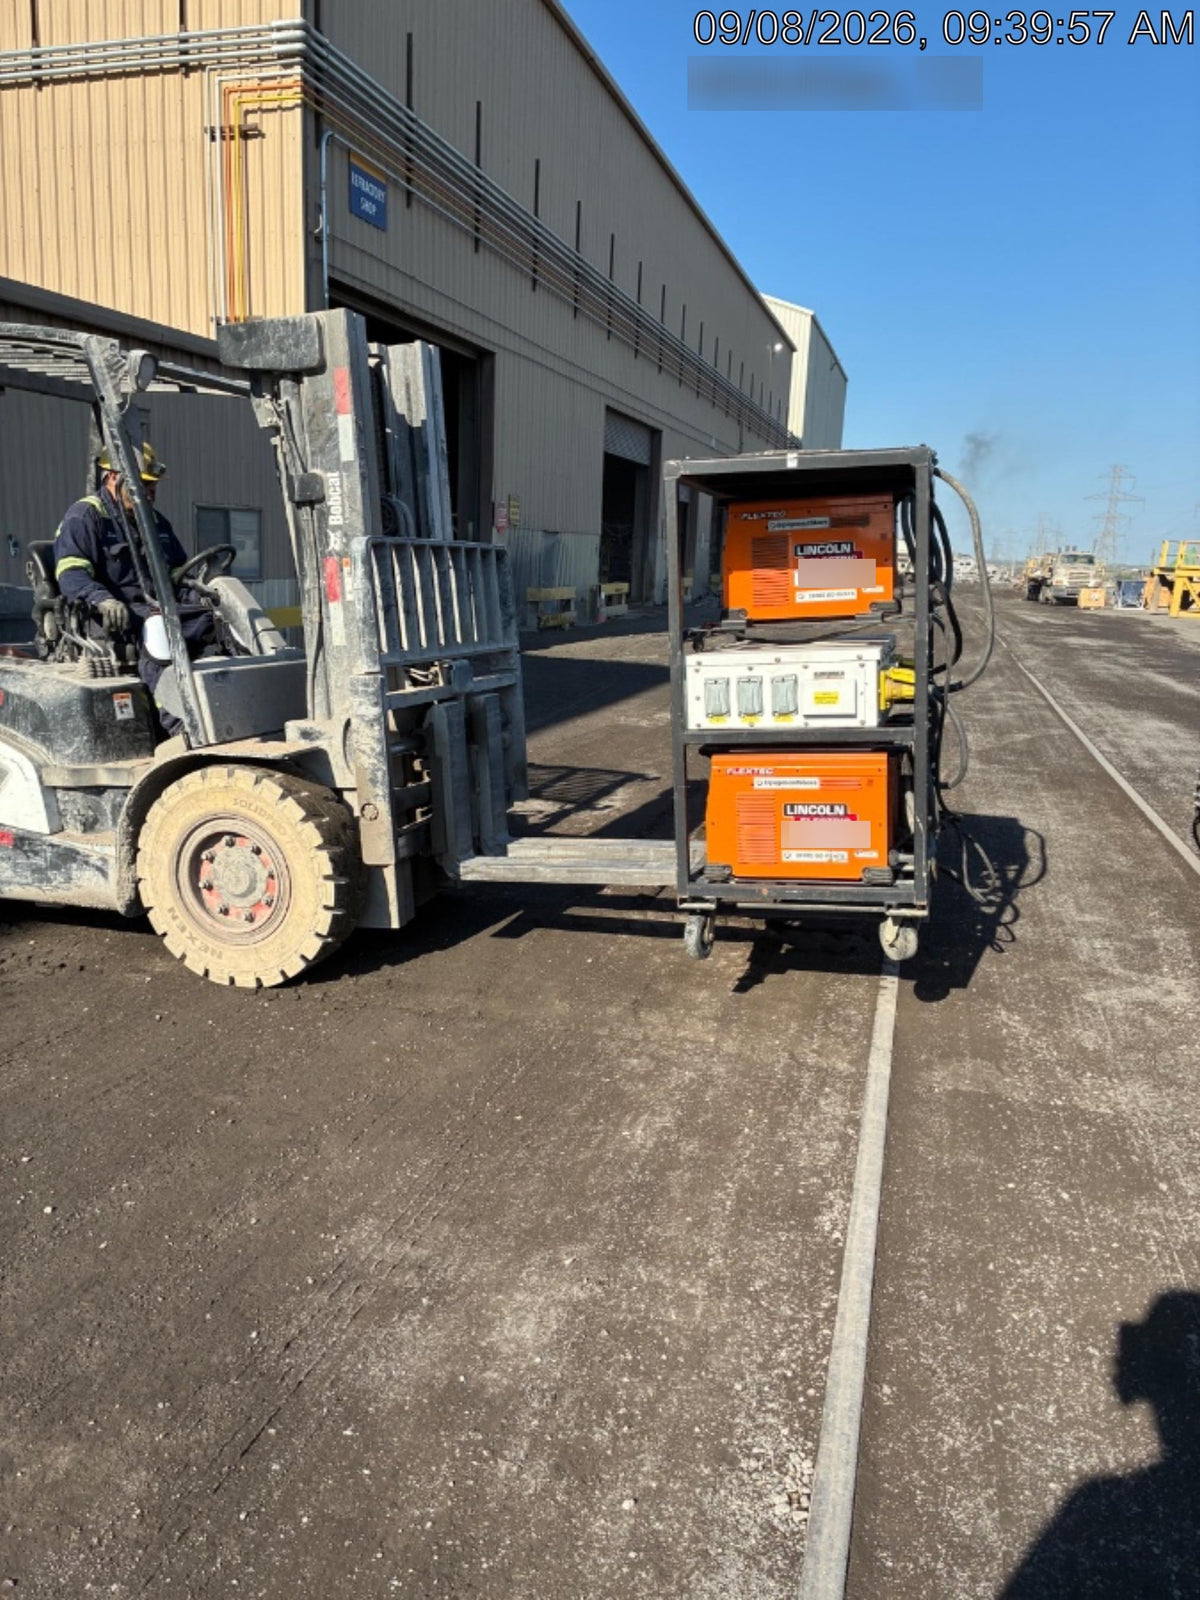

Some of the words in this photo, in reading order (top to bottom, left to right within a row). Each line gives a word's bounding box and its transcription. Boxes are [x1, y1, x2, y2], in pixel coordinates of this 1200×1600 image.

[326, 472, 342, 525] Bobcat
[797, 543, 851, 556] LINCOLN
[786, 804, 845, 816] LINCOLN
